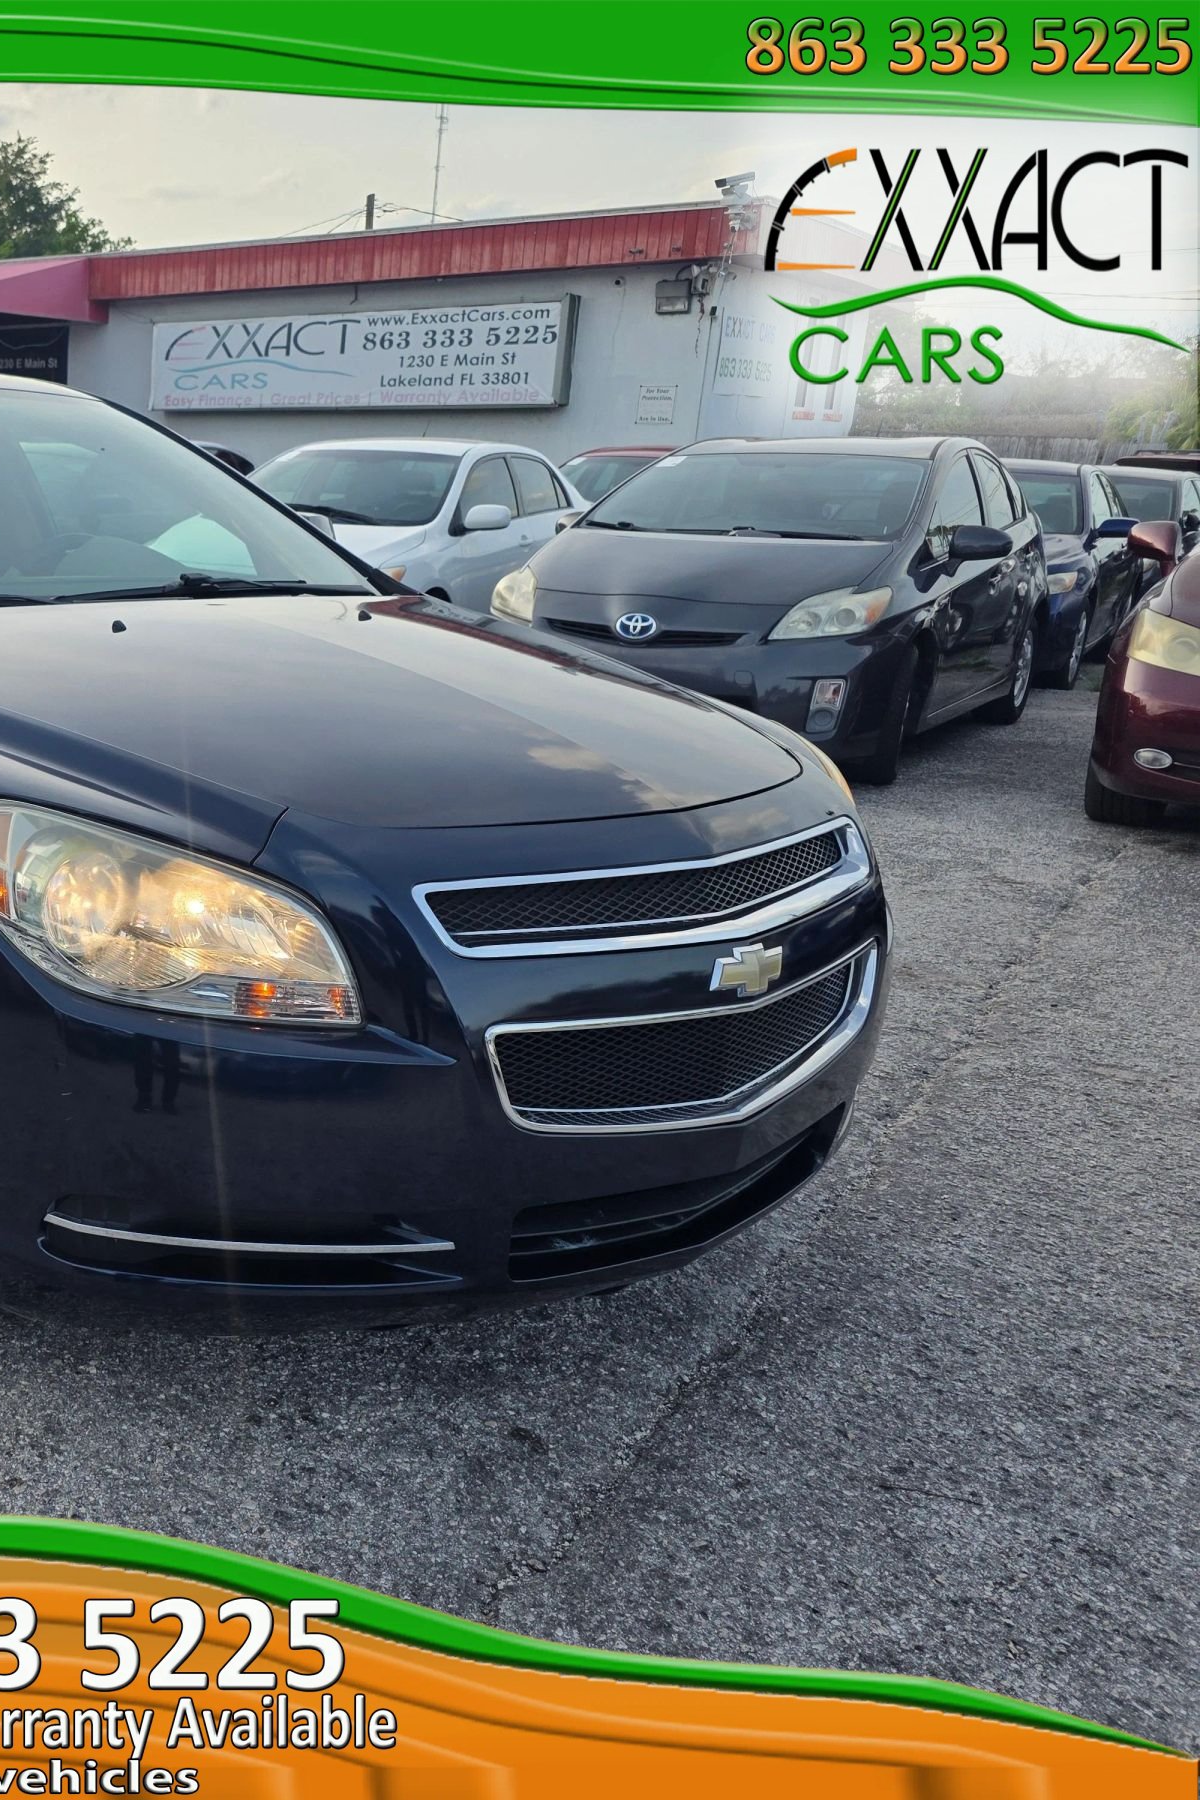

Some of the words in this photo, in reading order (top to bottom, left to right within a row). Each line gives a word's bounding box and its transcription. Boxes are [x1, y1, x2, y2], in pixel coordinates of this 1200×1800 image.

[367, 309, 550, 327] www.ExxactCars.com
[165, 319, 361, 361] EXXACT
[363, 331, 411, 351] 863
[422, 328, 473, 348] 333
[486, 324, 557, 346] 5225
[16, 358, 22, 369] E
[24, 357, 46, 369] Main
[47, 357, 58, 369] St
[400, 355, 434, 368] 1230
[440, 354, 449, 366] E
[454, 353, 494, 367] Main
[501, 352, 516, 365] St
[174, 372, 269, 390] CARS
[380, 373, 454, 387] Lakeland
[460, 373, 475, 386] FL
[481, 372, 529, 385] 33801
[164, 395, 193, 407] Easy
[200, 394, 253, 406] Finance
[271, 392, 312, 405] Great
[317, 392, 360, 405] Prices
[380, 390, 450, 405] Warranty
[458, 388, 540, 403] Available
